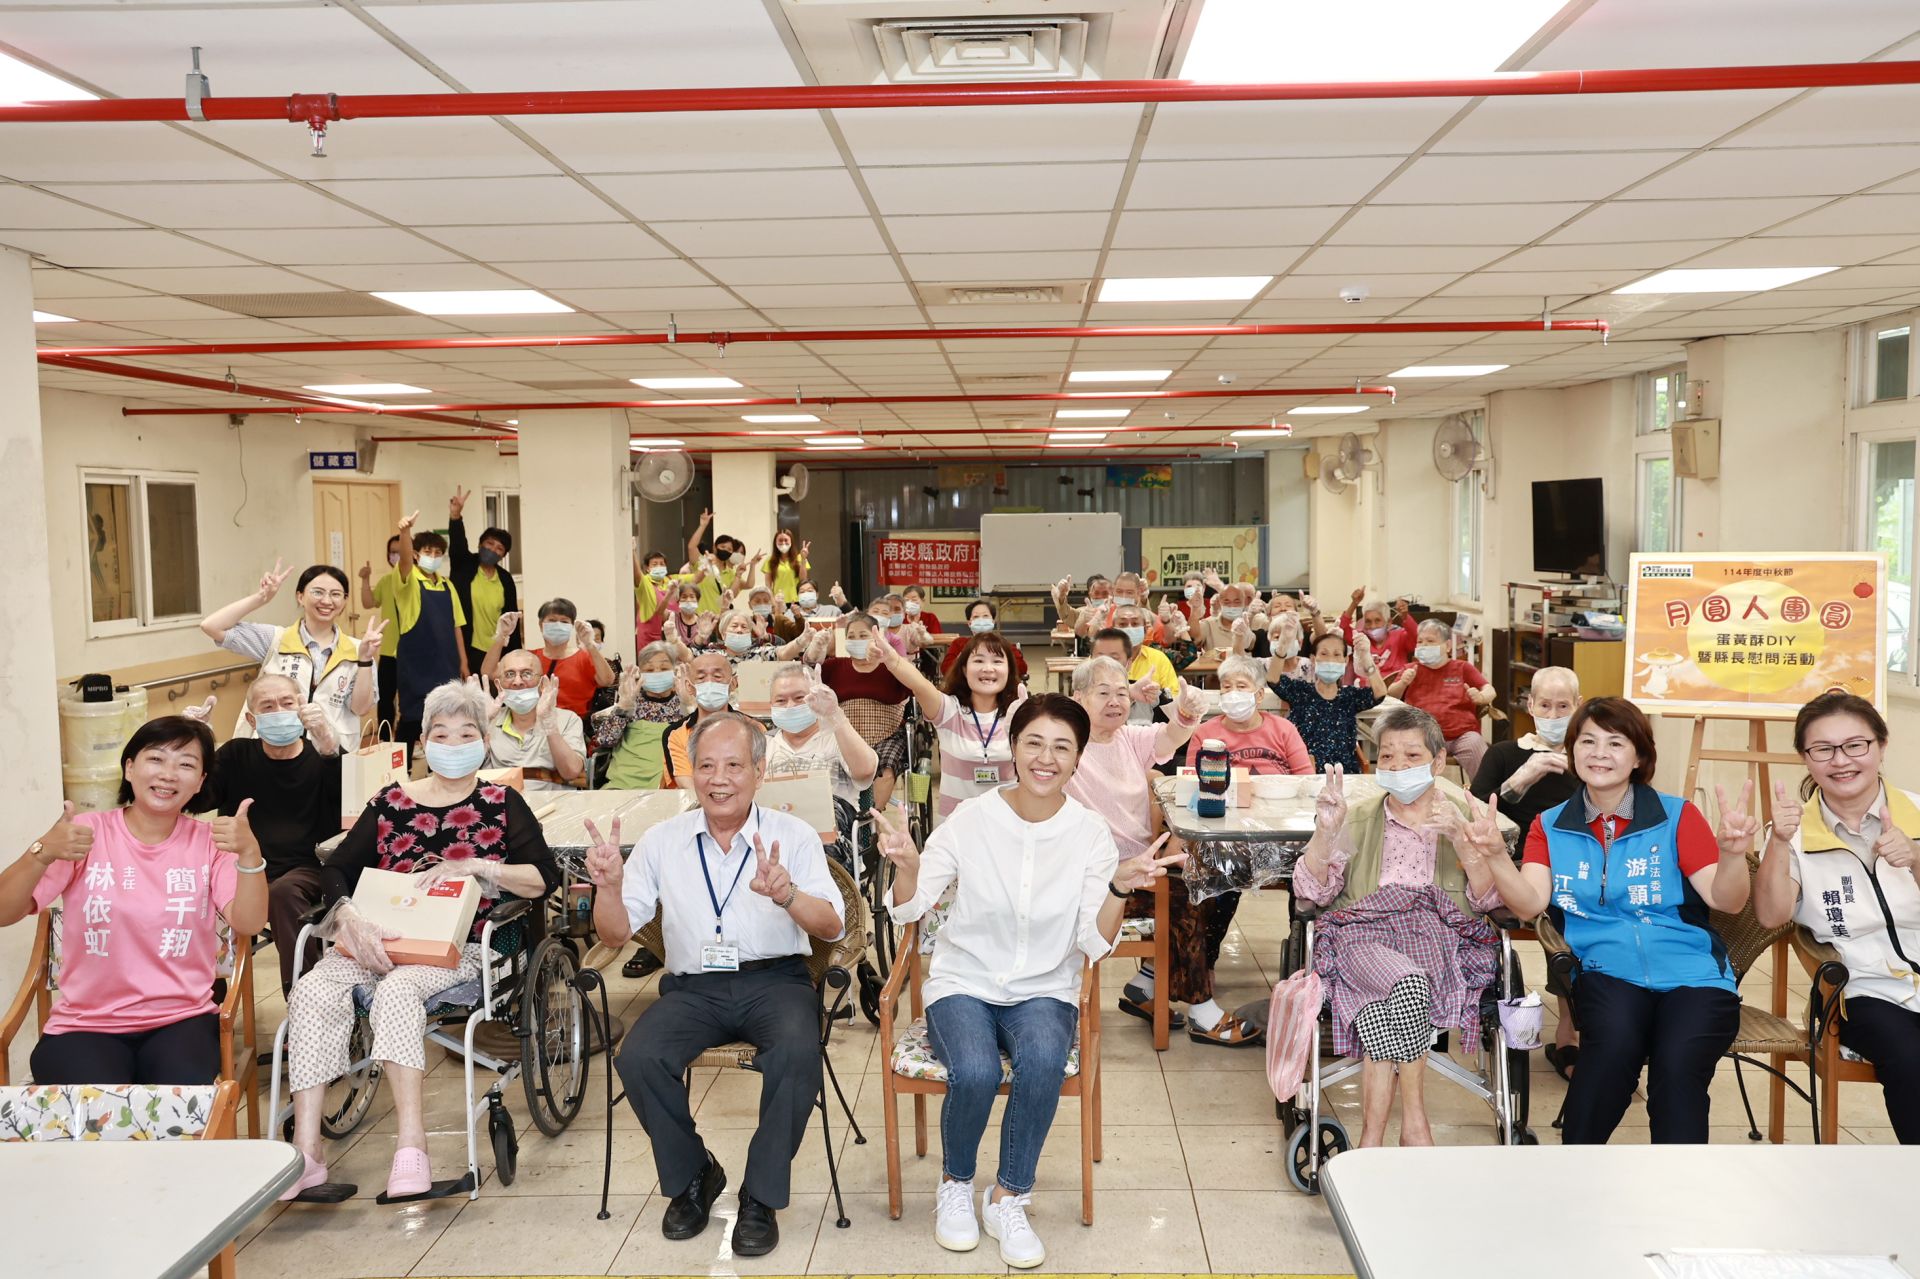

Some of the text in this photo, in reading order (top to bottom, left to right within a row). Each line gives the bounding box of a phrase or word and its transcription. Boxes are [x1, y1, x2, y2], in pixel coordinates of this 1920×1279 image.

[883, 542, 980, 562] 南投縣政府1
[1723, 568, 1794, 577] 114年度中秋節
[1665, 594, 1852, 630] 月圓人團圓
[1716, 633, 1797, 646] 蛋黃酥DIY
[1697, 650, 1816, 666] 暨縣長慰問活動
[122, 865, 136, 890] 主任
[1650, 854, 1662, 905] 立法委員
[1841, 875, 1856, 904] 副局長
[82, 861, 115, 957] 林依虹
[158, 867, 197, 958] 簡千翔
[1822, 890, 1851, 938] 賴瓊美
